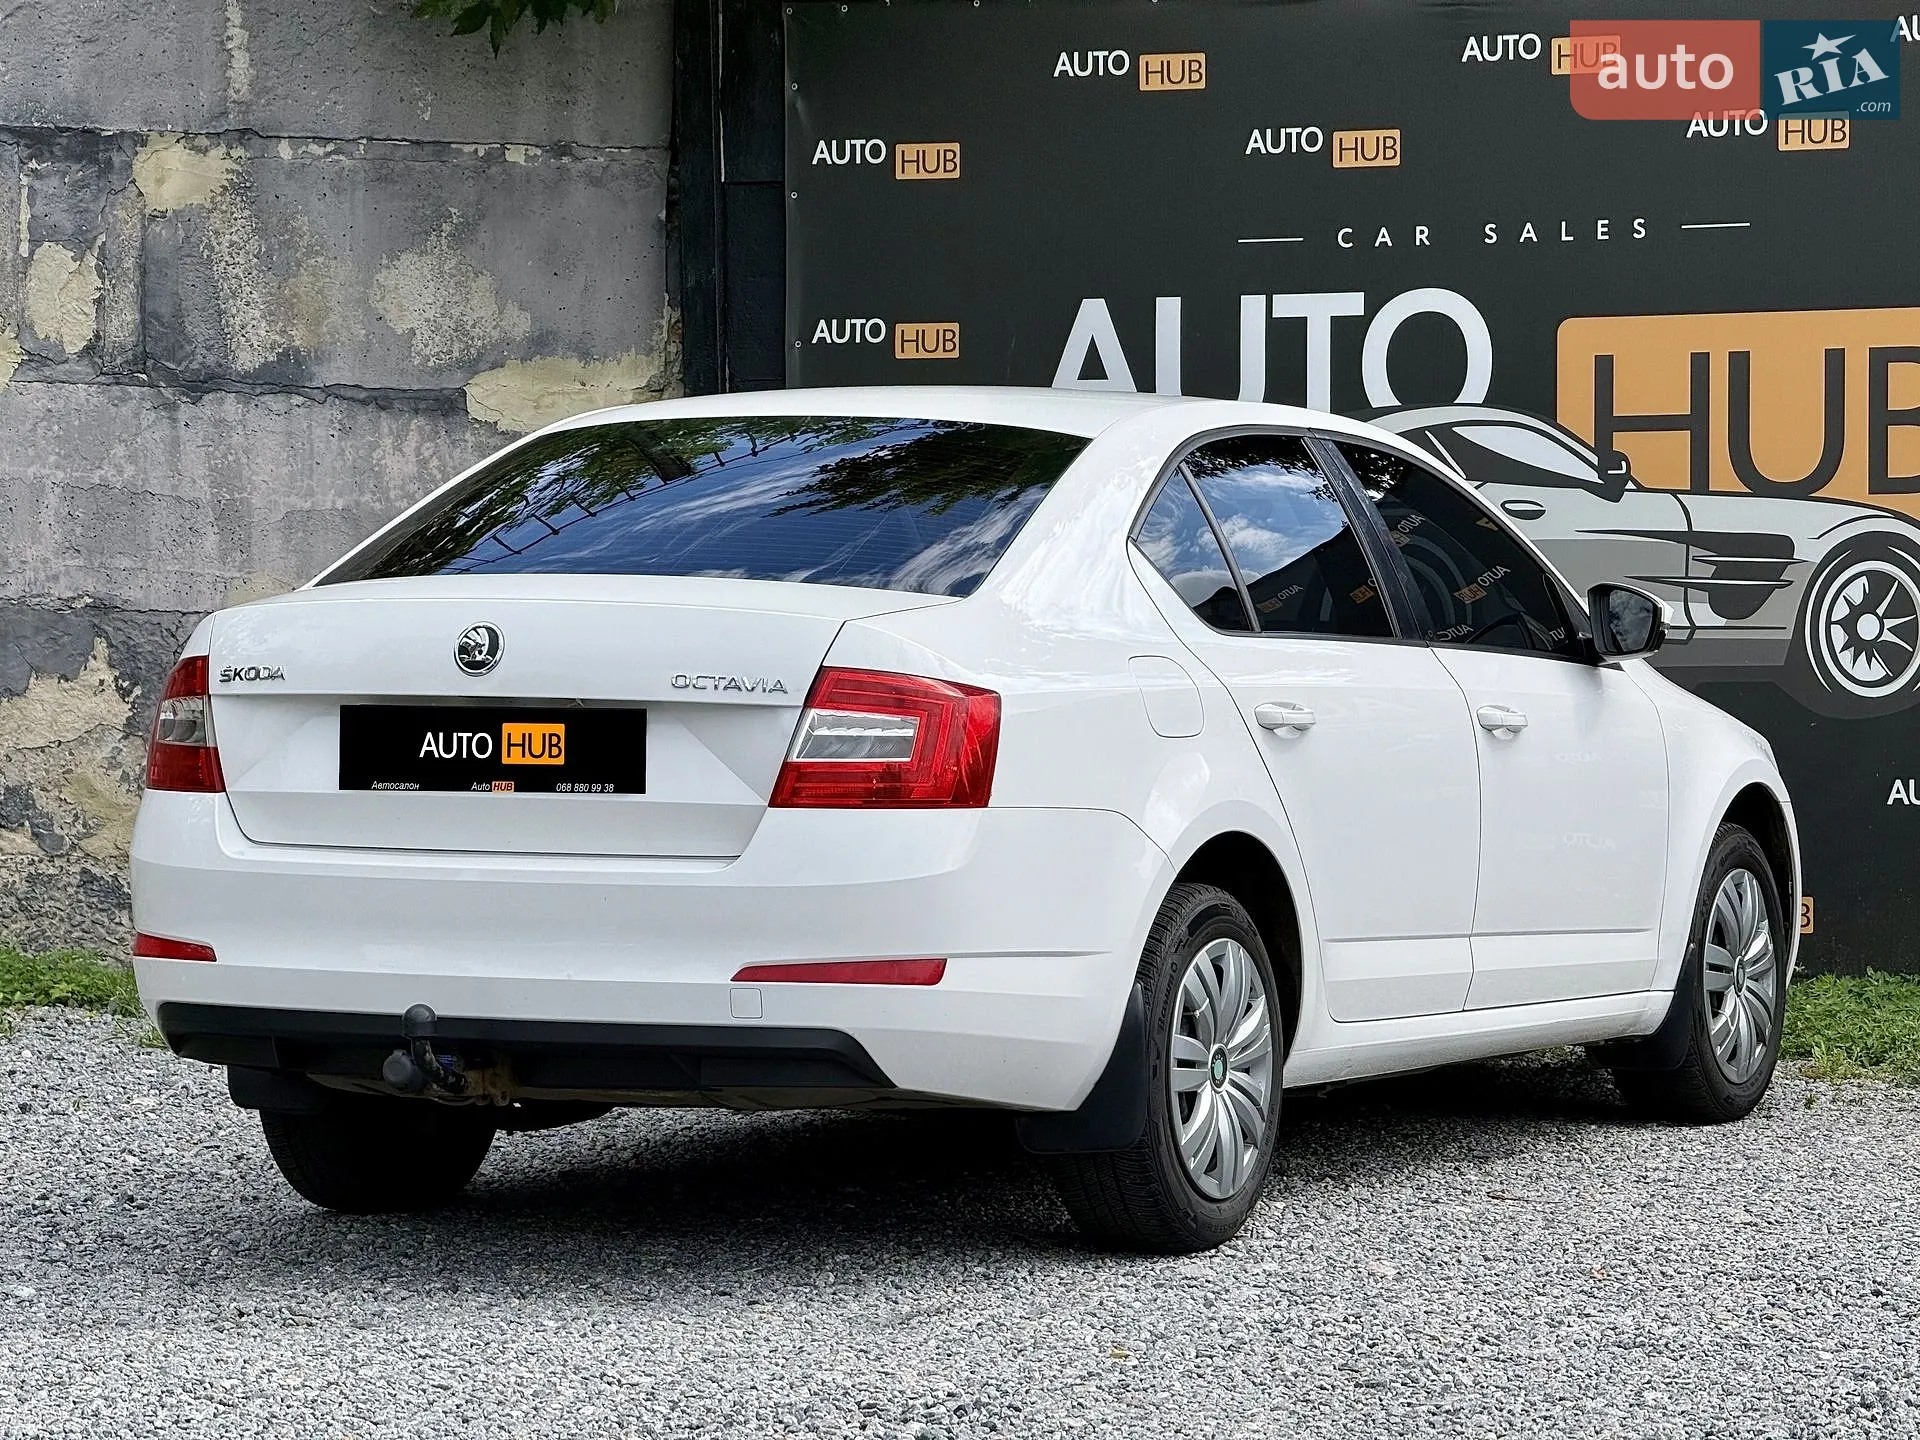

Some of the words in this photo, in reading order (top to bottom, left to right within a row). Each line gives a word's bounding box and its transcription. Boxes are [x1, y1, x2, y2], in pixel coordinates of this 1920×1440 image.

[1461, 33, 1542, 62] AUTO
[1053, 49, 1130, 77] AUTO
[1144, 58, 1203, 85] HUB
[1685, 108, 1769, 139] AUTO
[1782, 117, 1848, 145] HUB
[811, 138, 887, 165] AUTO
[900, 148, 957, 175] HUB
[1245, 126, 1324, 155] AUTO
[1338, 135, 1398, 163] HUB
[1337, 225, 1432, 248] CAR
[1483, 217, 1647, 244] SALES
[811, 317, 887, 344] AUTO
[900, 327, 956, 354] HUB
[1051, 287, 1493, 414] AUTO
[219, 665, 286, 683] ŠKODA
[671, 673, 788, 694] OCTAVIA
[419, 731, 493, 759] AUTO
[506, 732, 563, 759] HUB
[371, 780, 420, 791] Автосалон
[470, 781, 490, 791] Auto
[492, 782, 513, 792] HUB
[556, 782, 572, 792] 068
[574, 782, 590, 792] 880
[591, 783, 602, 793] 99
[603, 783, 615, 793] 38
